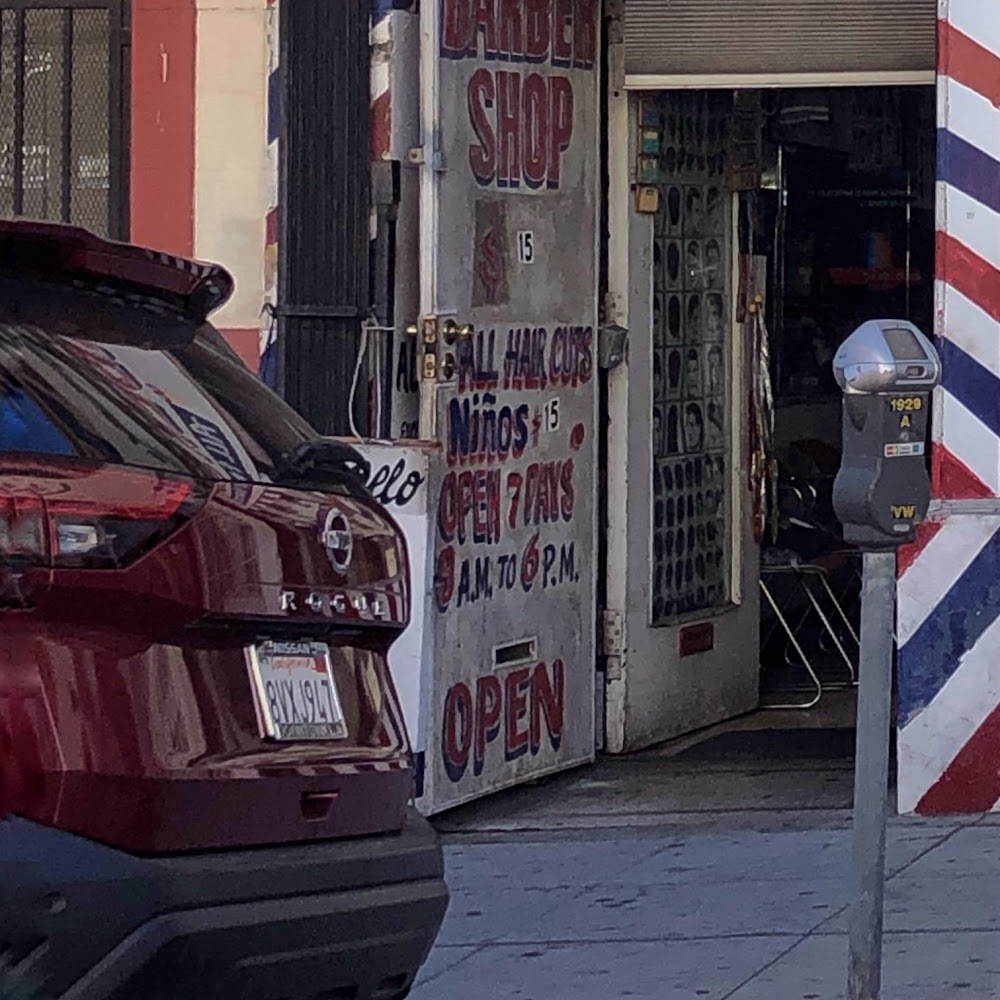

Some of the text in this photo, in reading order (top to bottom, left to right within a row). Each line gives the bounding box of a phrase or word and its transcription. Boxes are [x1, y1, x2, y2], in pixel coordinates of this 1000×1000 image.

[467, 67, 574, 190] SHOP
[519, 232, 533, 262] 15
[545, 402, 558, 431] 15
[439, 469, 501, 545] OPEN
[507, 472, 523, 529] 7
[498, 553, 517, 590] TO
[521, 532, 540, 592] 6
[543, 541, 579, 589] P.M.
[281, 590, 386, 616] ROGUE
[441, 658, 564, 783] OPEN
